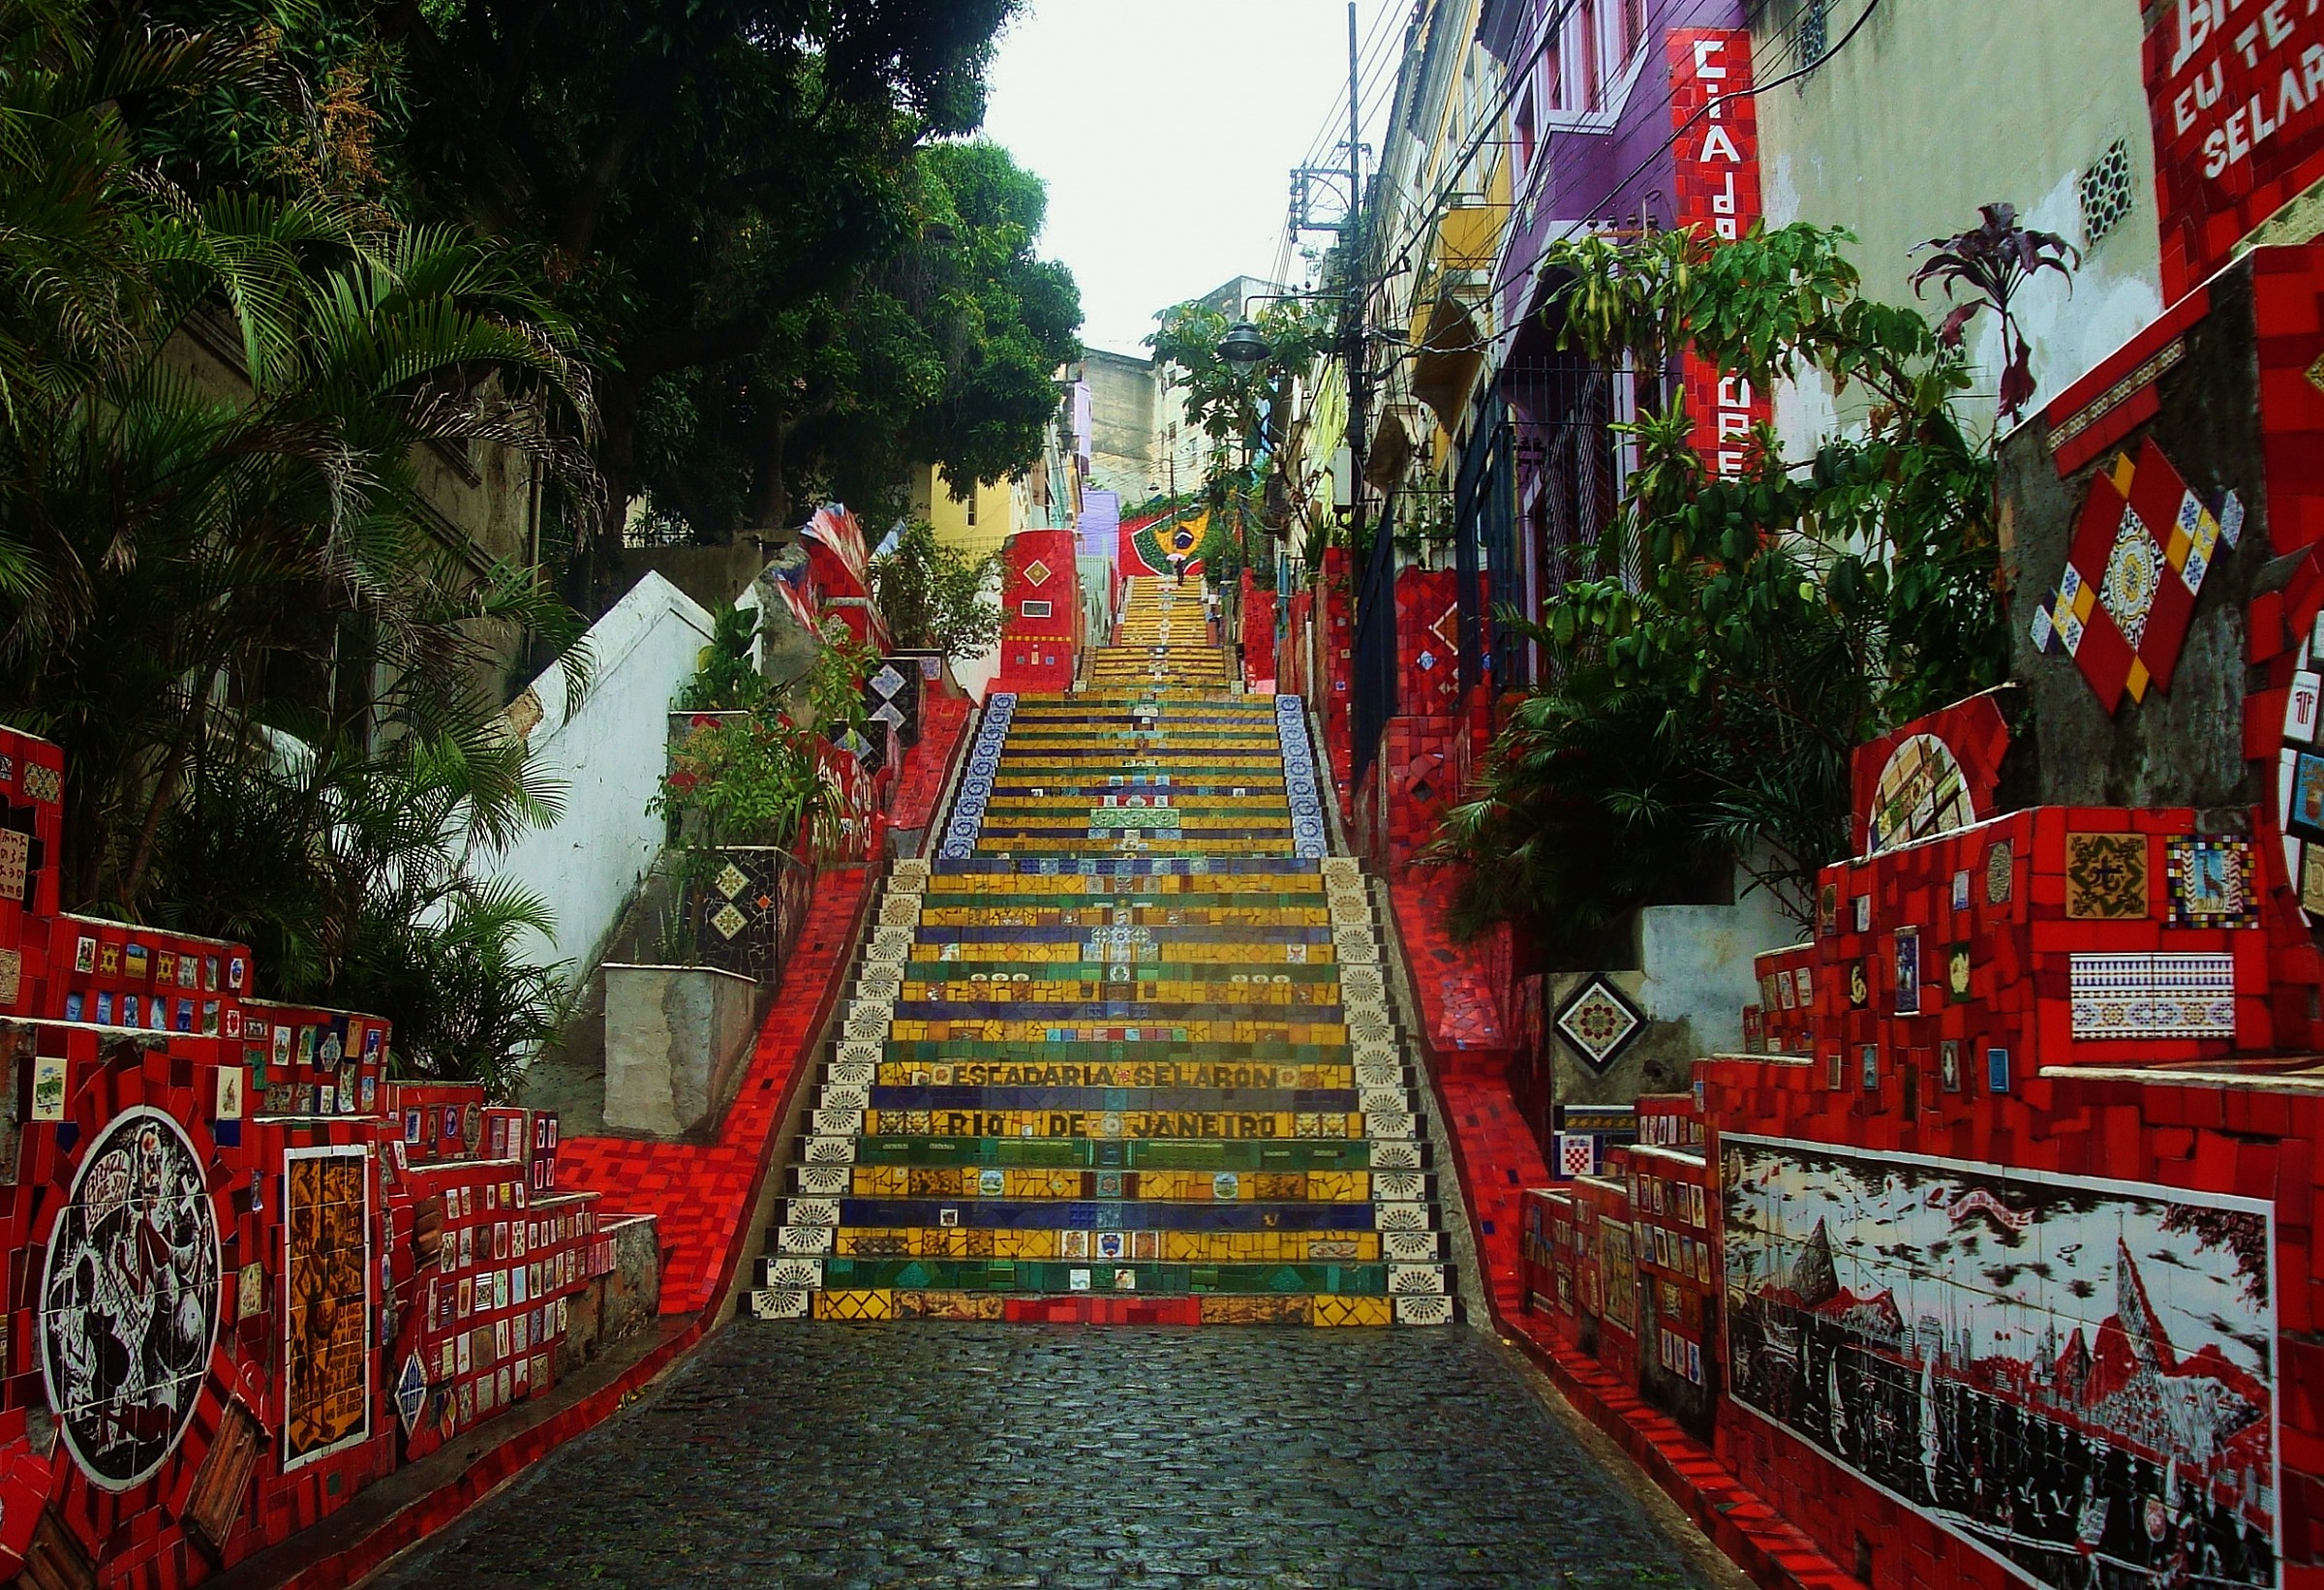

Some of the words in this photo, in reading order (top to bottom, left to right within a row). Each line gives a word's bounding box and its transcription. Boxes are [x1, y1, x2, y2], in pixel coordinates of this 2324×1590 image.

[2174, 57, 2224, 137] EU
[2235, 0, 2296, 69] TE
[953, 1064, 1114, 1086] ESCADARIA
[948, 1116, 1005, 1137] RIO
[1050, 1115, 1087, 1137] DE
[1131, 1115, 1276, 1138] JANEIRO
